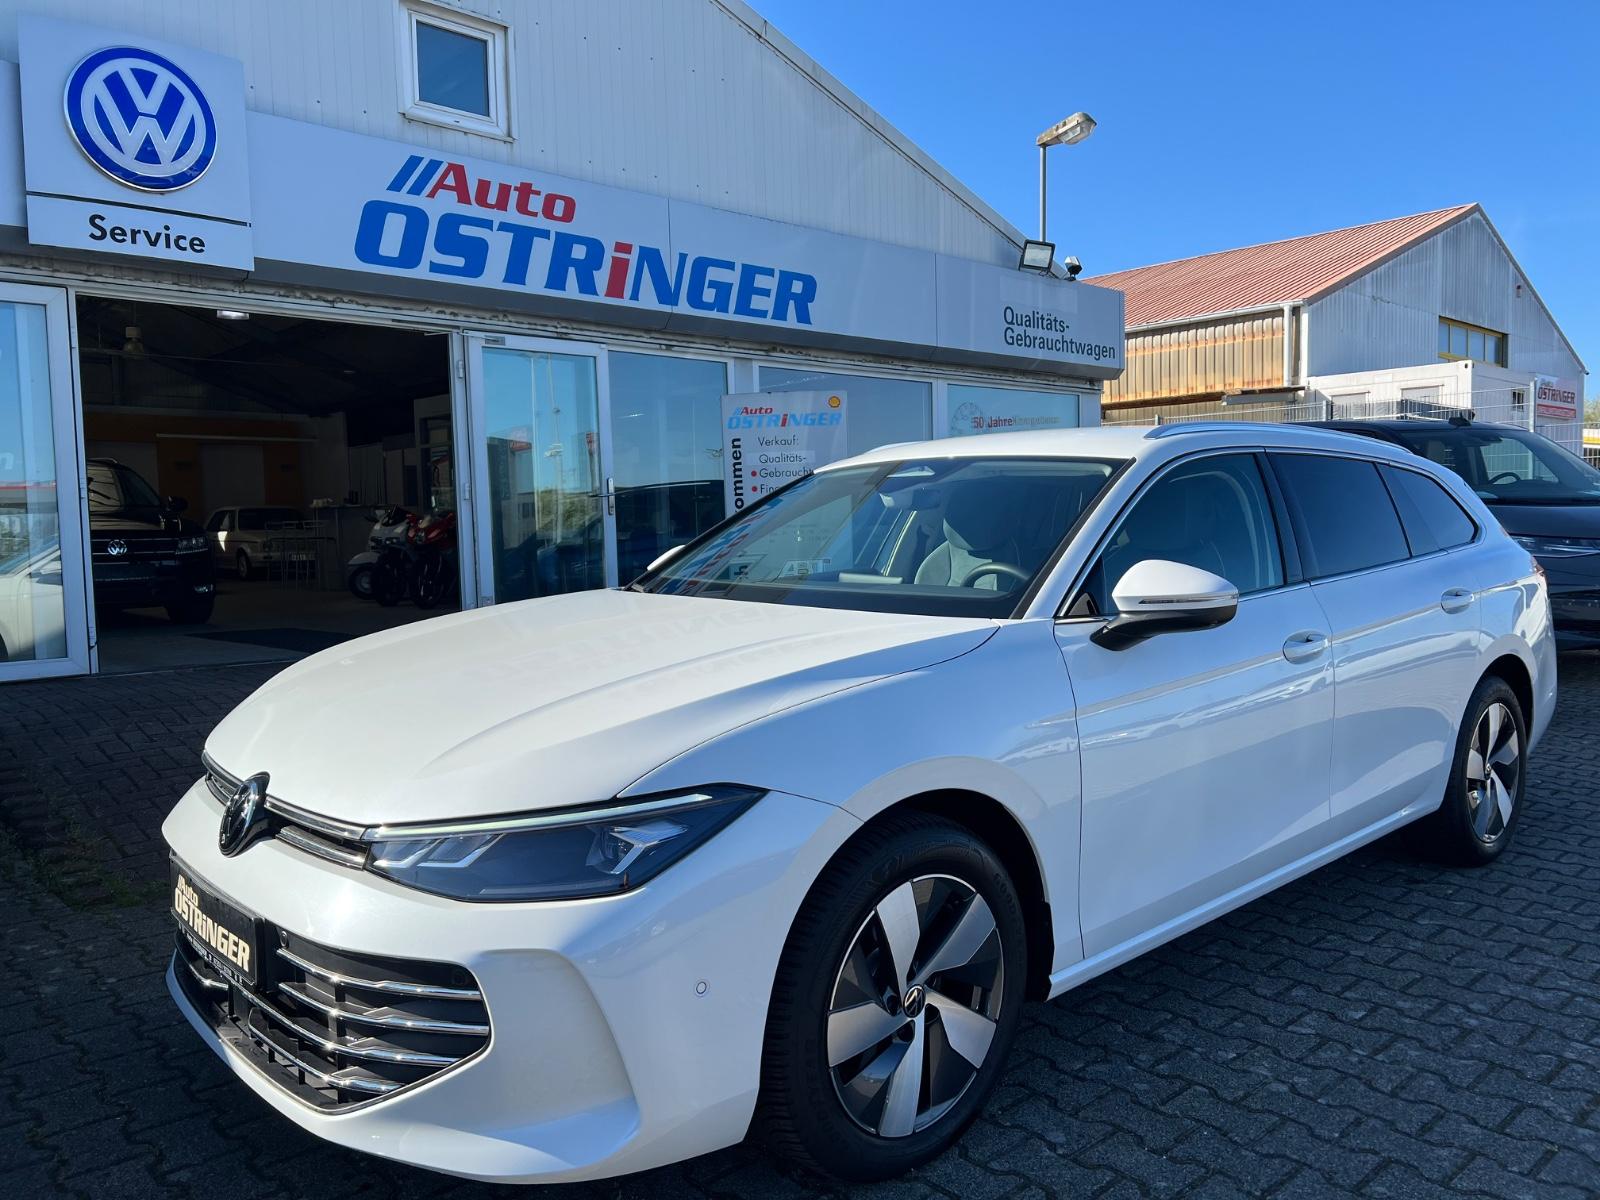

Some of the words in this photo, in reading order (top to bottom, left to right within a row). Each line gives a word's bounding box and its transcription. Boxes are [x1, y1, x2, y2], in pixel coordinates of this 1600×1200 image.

[425, 162, 577, 224] Auto
[88, 214, 206, 254] Service
[354, 200, 818, 325] OSTRiNGER
[1003, 306, 1070, 333] Qualitäts-
[1003, 326, 1116, 361] Gebrauchtwagen
[740, 406, 774, 416] Auto
[972, 416, 985, 429] 50
[987, 415, 1014, 429] Jahre
[757, 435, 799, 447] Verkauf:
[759, 451, 807, 464] Qualitäts-
[731, 437, 746, 513] ommen
[174, 887, 250, 973] OSTRiNGER
